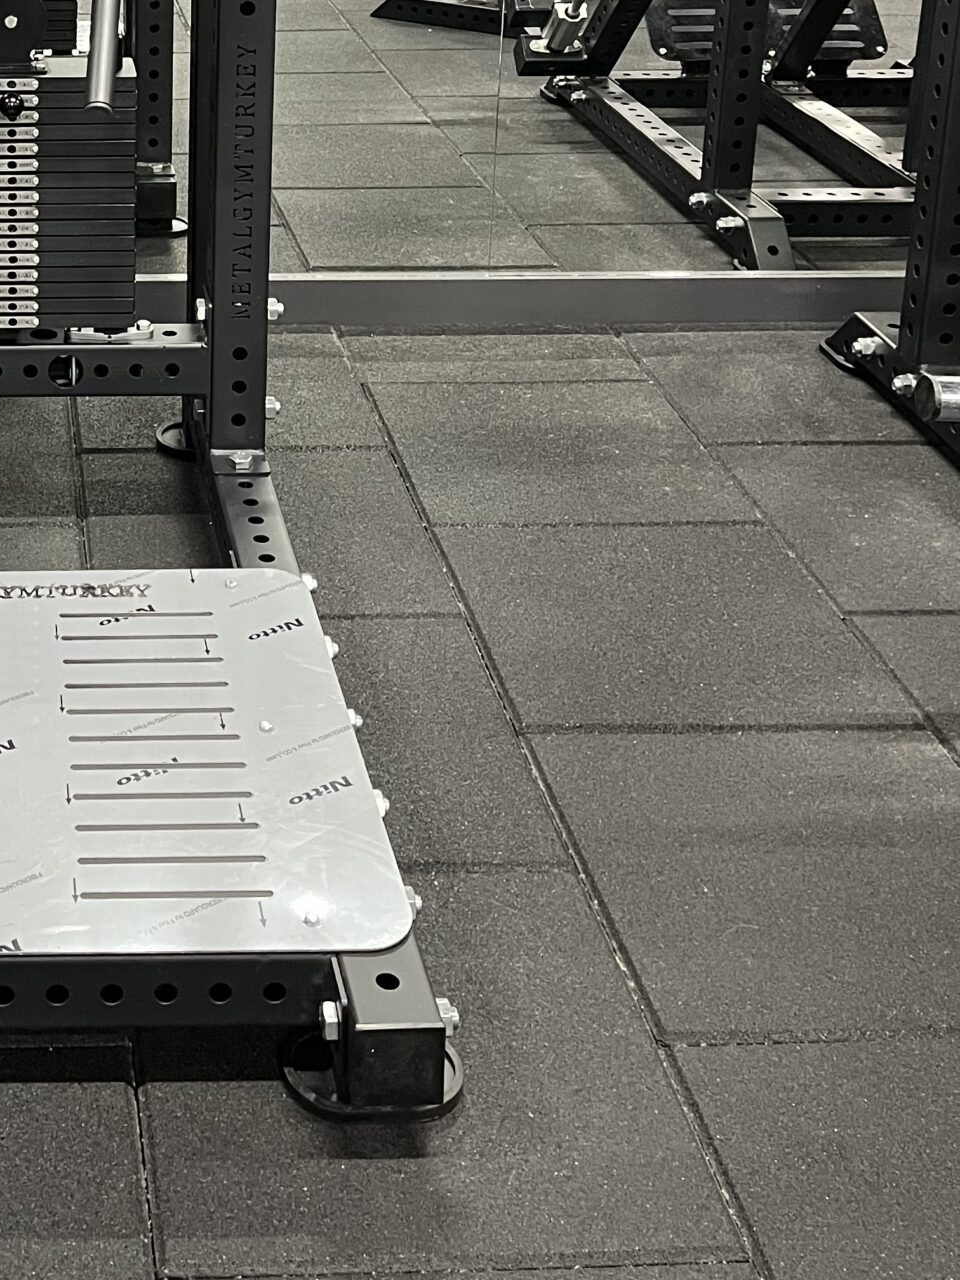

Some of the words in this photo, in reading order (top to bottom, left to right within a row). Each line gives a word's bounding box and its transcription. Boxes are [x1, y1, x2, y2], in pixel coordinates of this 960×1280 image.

[231, 44, 257, 320] METALGYMTURKEY
[99, 604, 156, 626] Ntto
[248, 618, 304, 641] Nitto
[288, 775, 354, 805] Nitto
